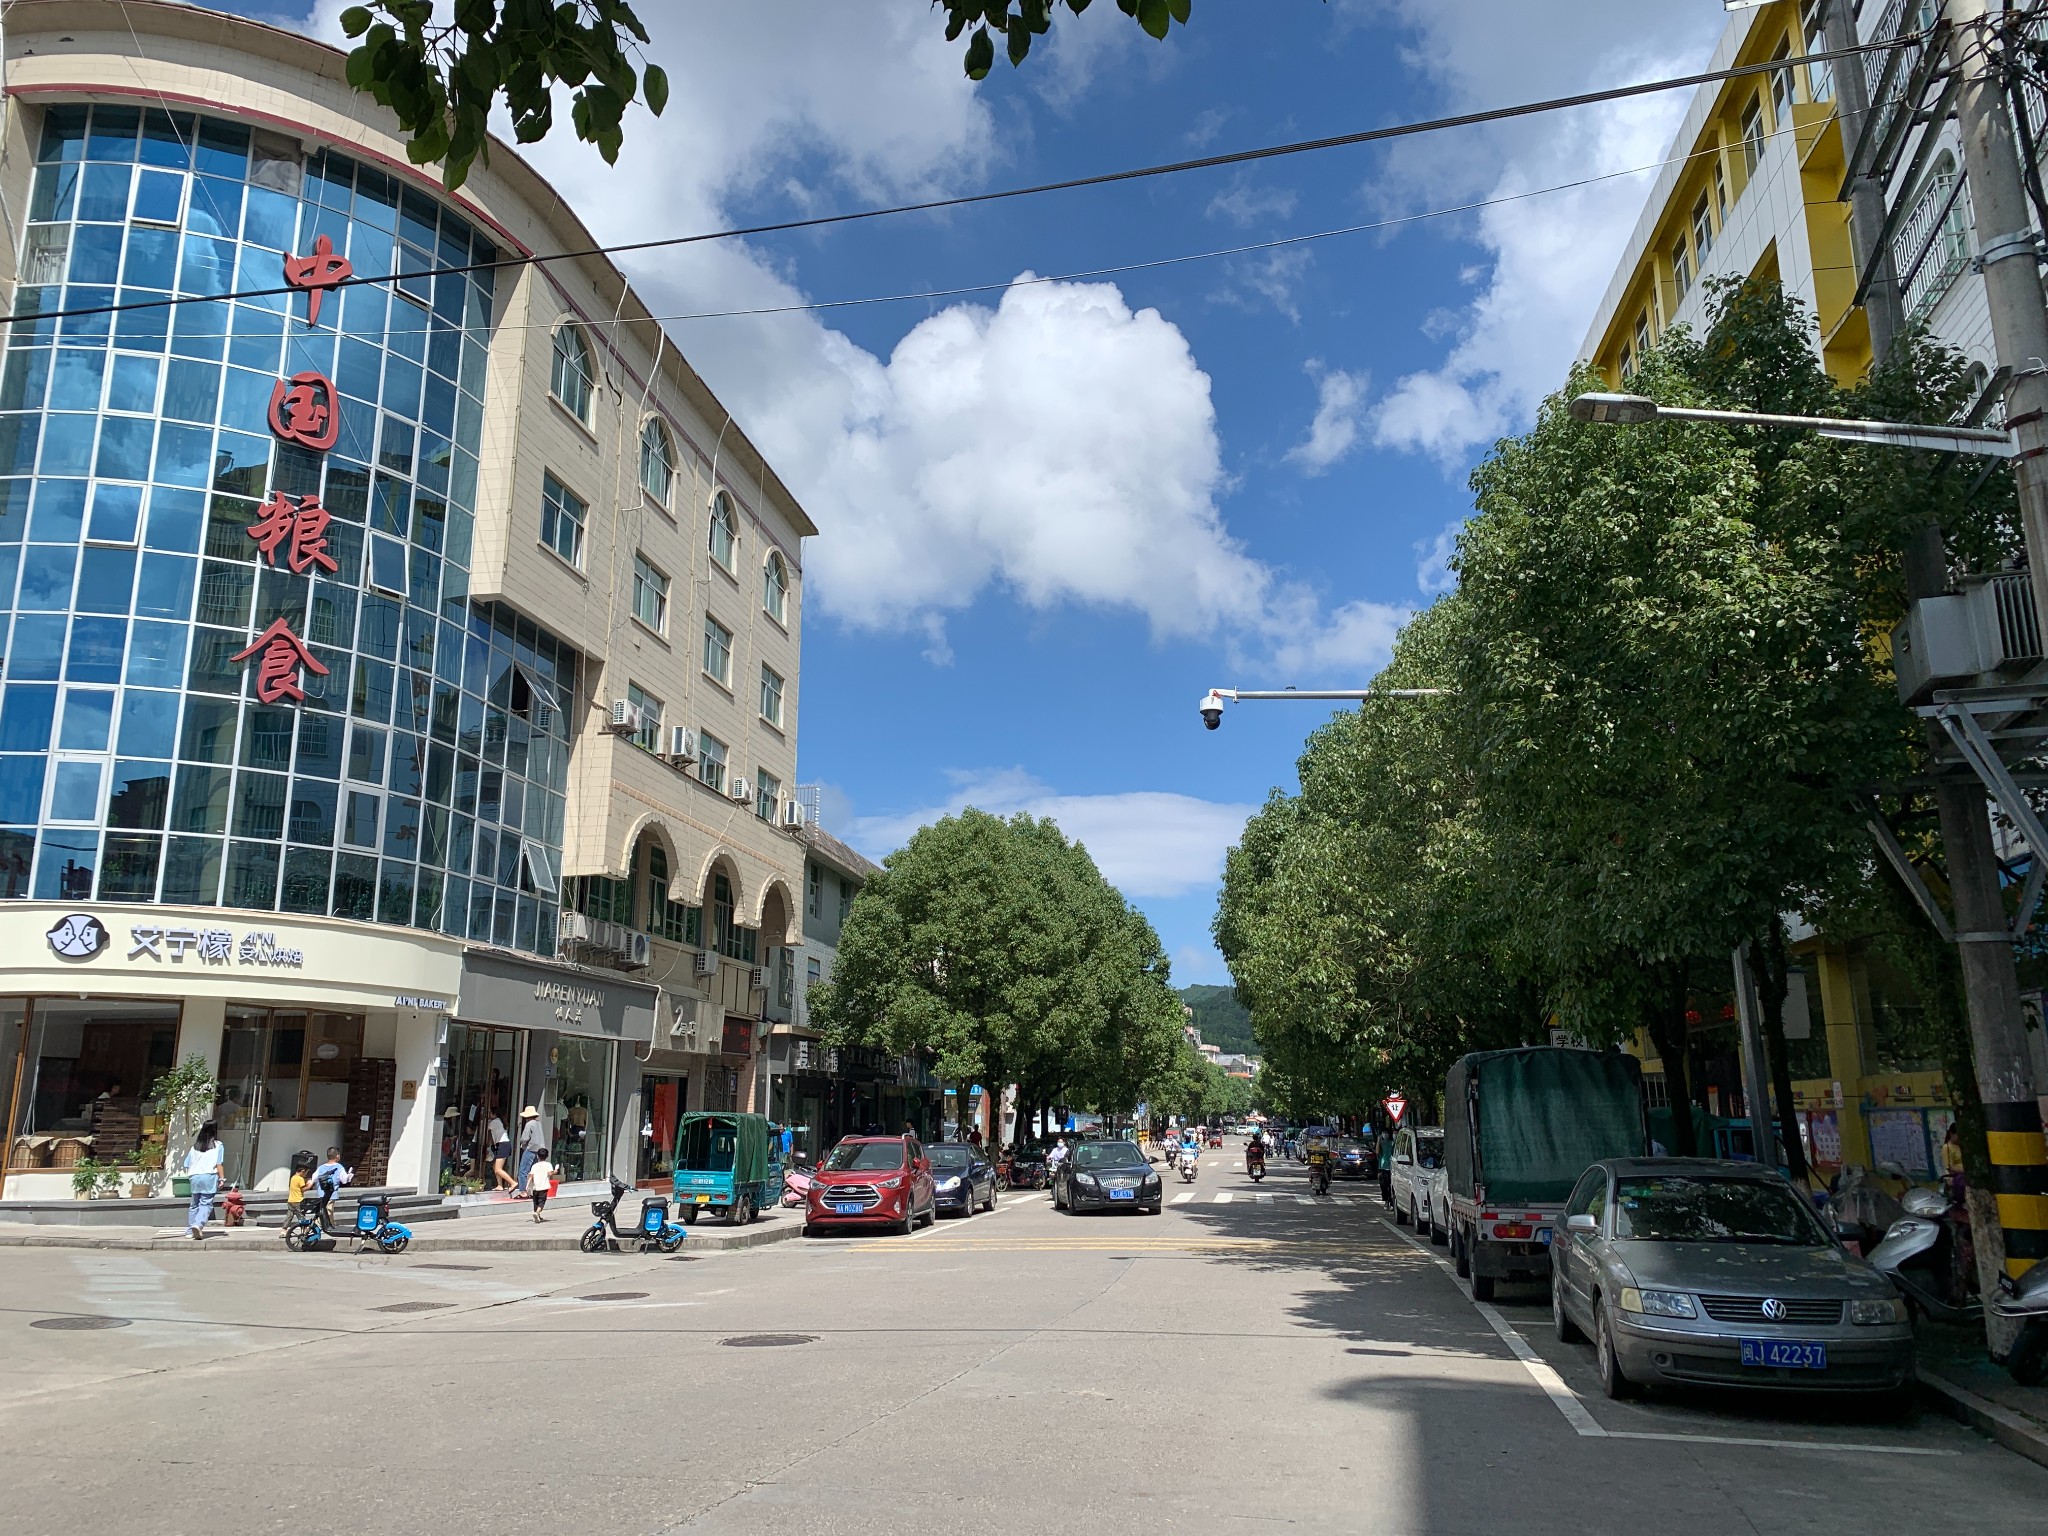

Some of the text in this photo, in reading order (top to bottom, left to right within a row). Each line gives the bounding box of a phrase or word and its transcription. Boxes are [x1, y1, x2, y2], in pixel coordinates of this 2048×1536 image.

[231, 234, 353, 705] 中国粮食
[127, 924, 233, 959] 艾宁檬
[239, 945, 304, 964] 安心烘焙
[419, 998, 447, 1010] BAKERY
[533, 980, 606, 1008] JIARENYUAN
[669, 1004, 697, 1036] 2号店
[1556, 1034, 1584, 1048] 学校
